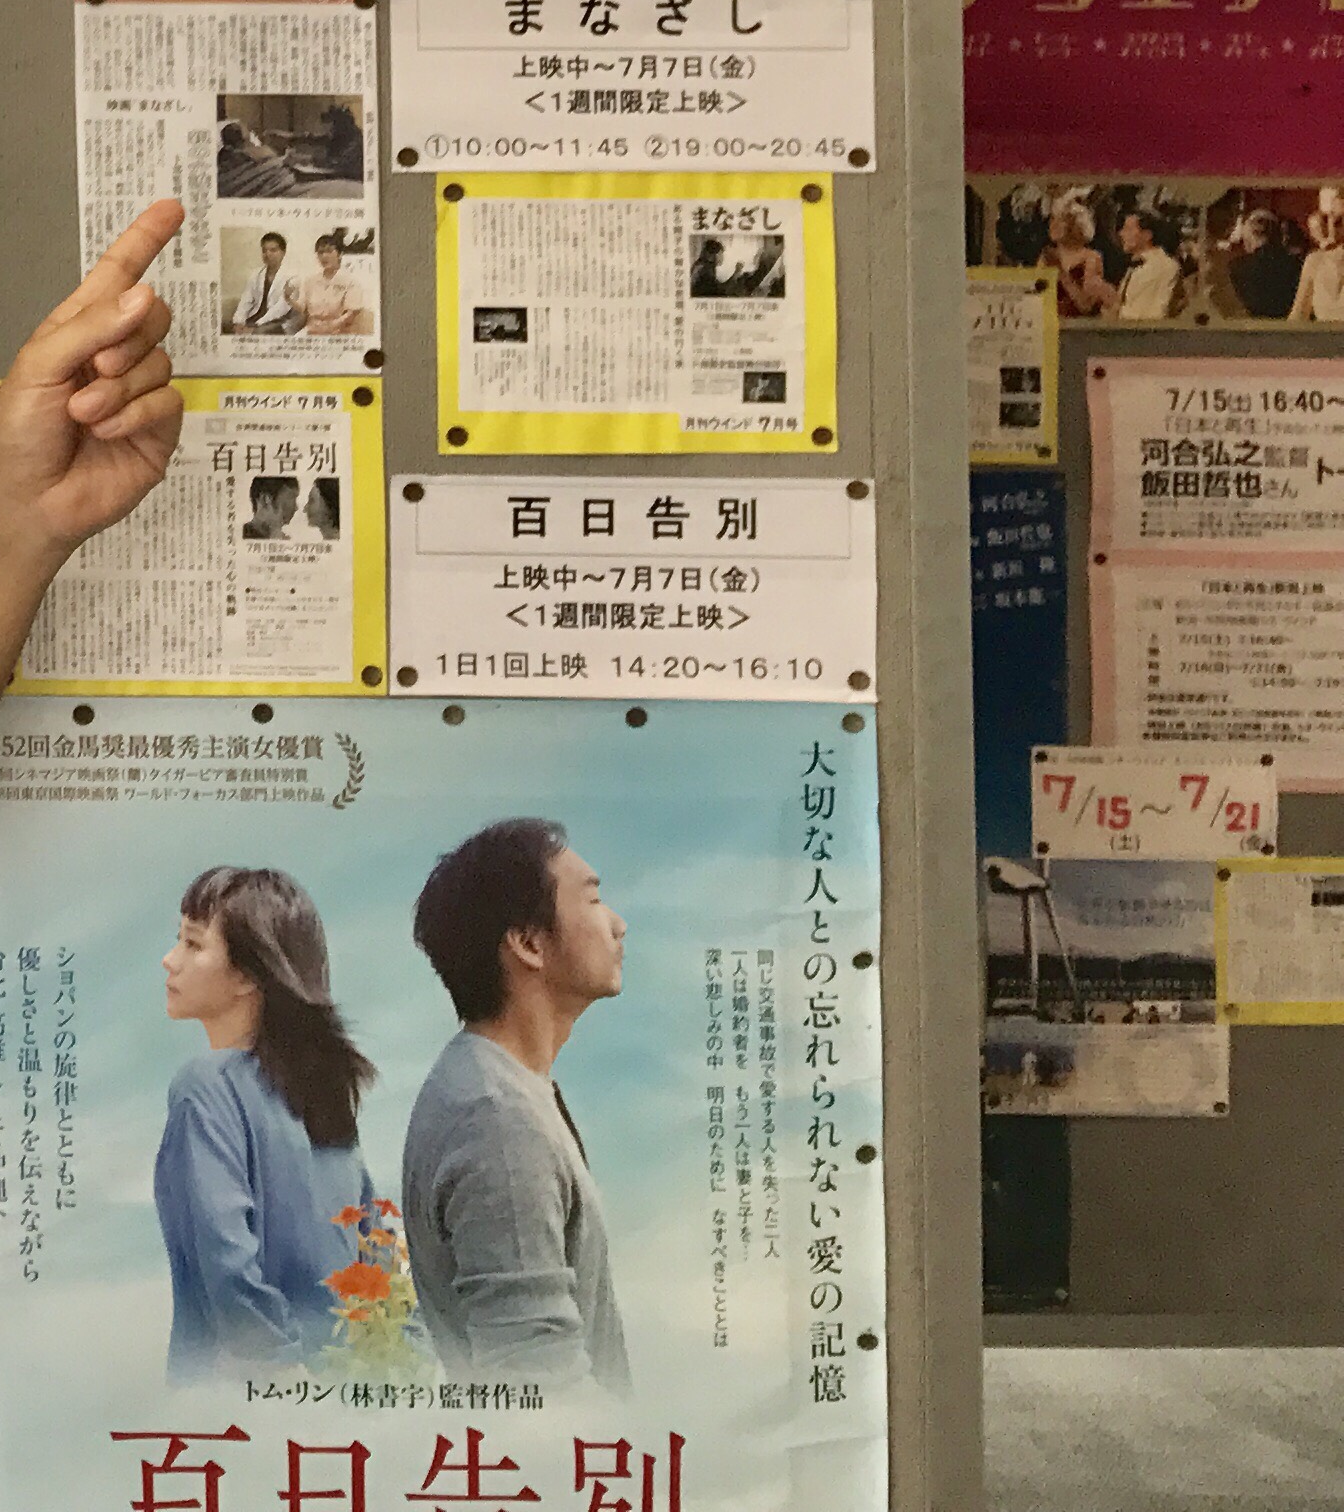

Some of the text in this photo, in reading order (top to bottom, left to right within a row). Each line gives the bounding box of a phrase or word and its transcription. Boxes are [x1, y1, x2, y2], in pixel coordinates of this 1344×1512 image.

[513, 55, 756, 80] 上映中～7月7日(金)
[425, 136, 846, 159] ①10:00～11:45 ②19:00～20:45
[691, 206, 782, 232] まなざし
[223, 394, 292, 409] 月刊ウインド
[206, 440, 337, 474] 百日告別
[507, 496, 759, 541] 百日告別
[494, 563, 761, 593] 上映中～7月7日(金)
[436, 652, 824, 681] 1日1回上映 14:20～16:10
[52, 945, 78, 1211] ショパンの旋律とともに
[799, 739, 847, 1404] 大切な人との忘れられない愛の記憶
[16, 945, 42, 1284] 優しさと温もりを伝えながら
[244, 1378, 545, 1412] トム・リン(林書宇)監督作品
